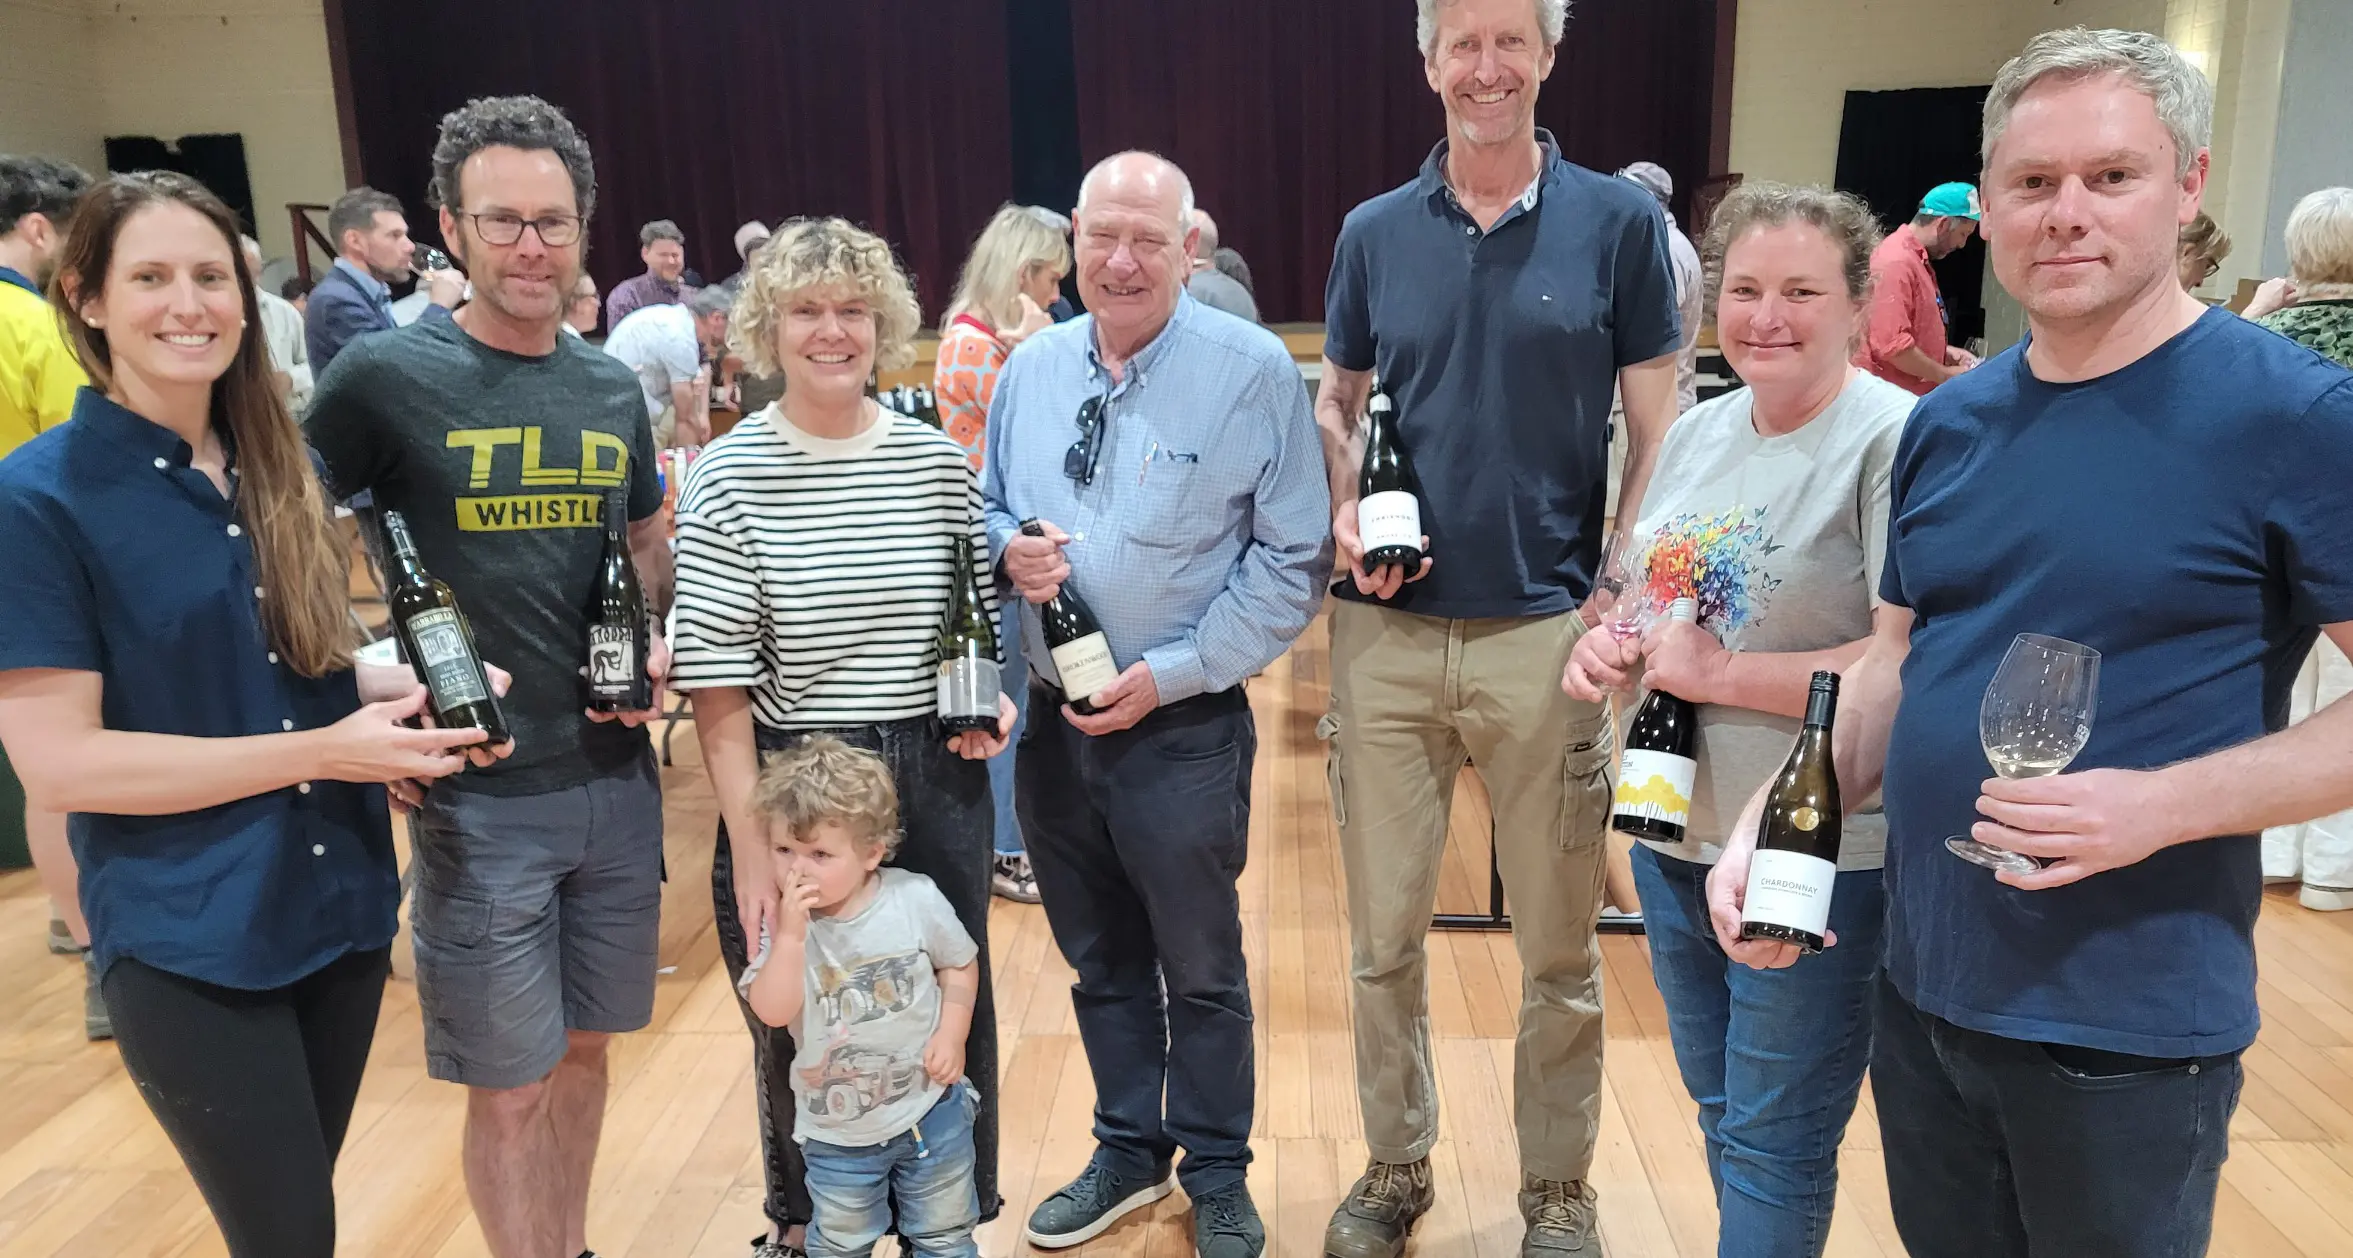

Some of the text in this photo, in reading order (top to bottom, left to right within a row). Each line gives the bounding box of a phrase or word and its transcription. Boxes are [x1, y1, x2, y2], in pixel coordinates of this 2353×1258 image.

[446, 426, 629, 488] TLD
[440, 673, 470, 688] FIANO
[1760, 877, 1818, 895] CHARDONNAY
